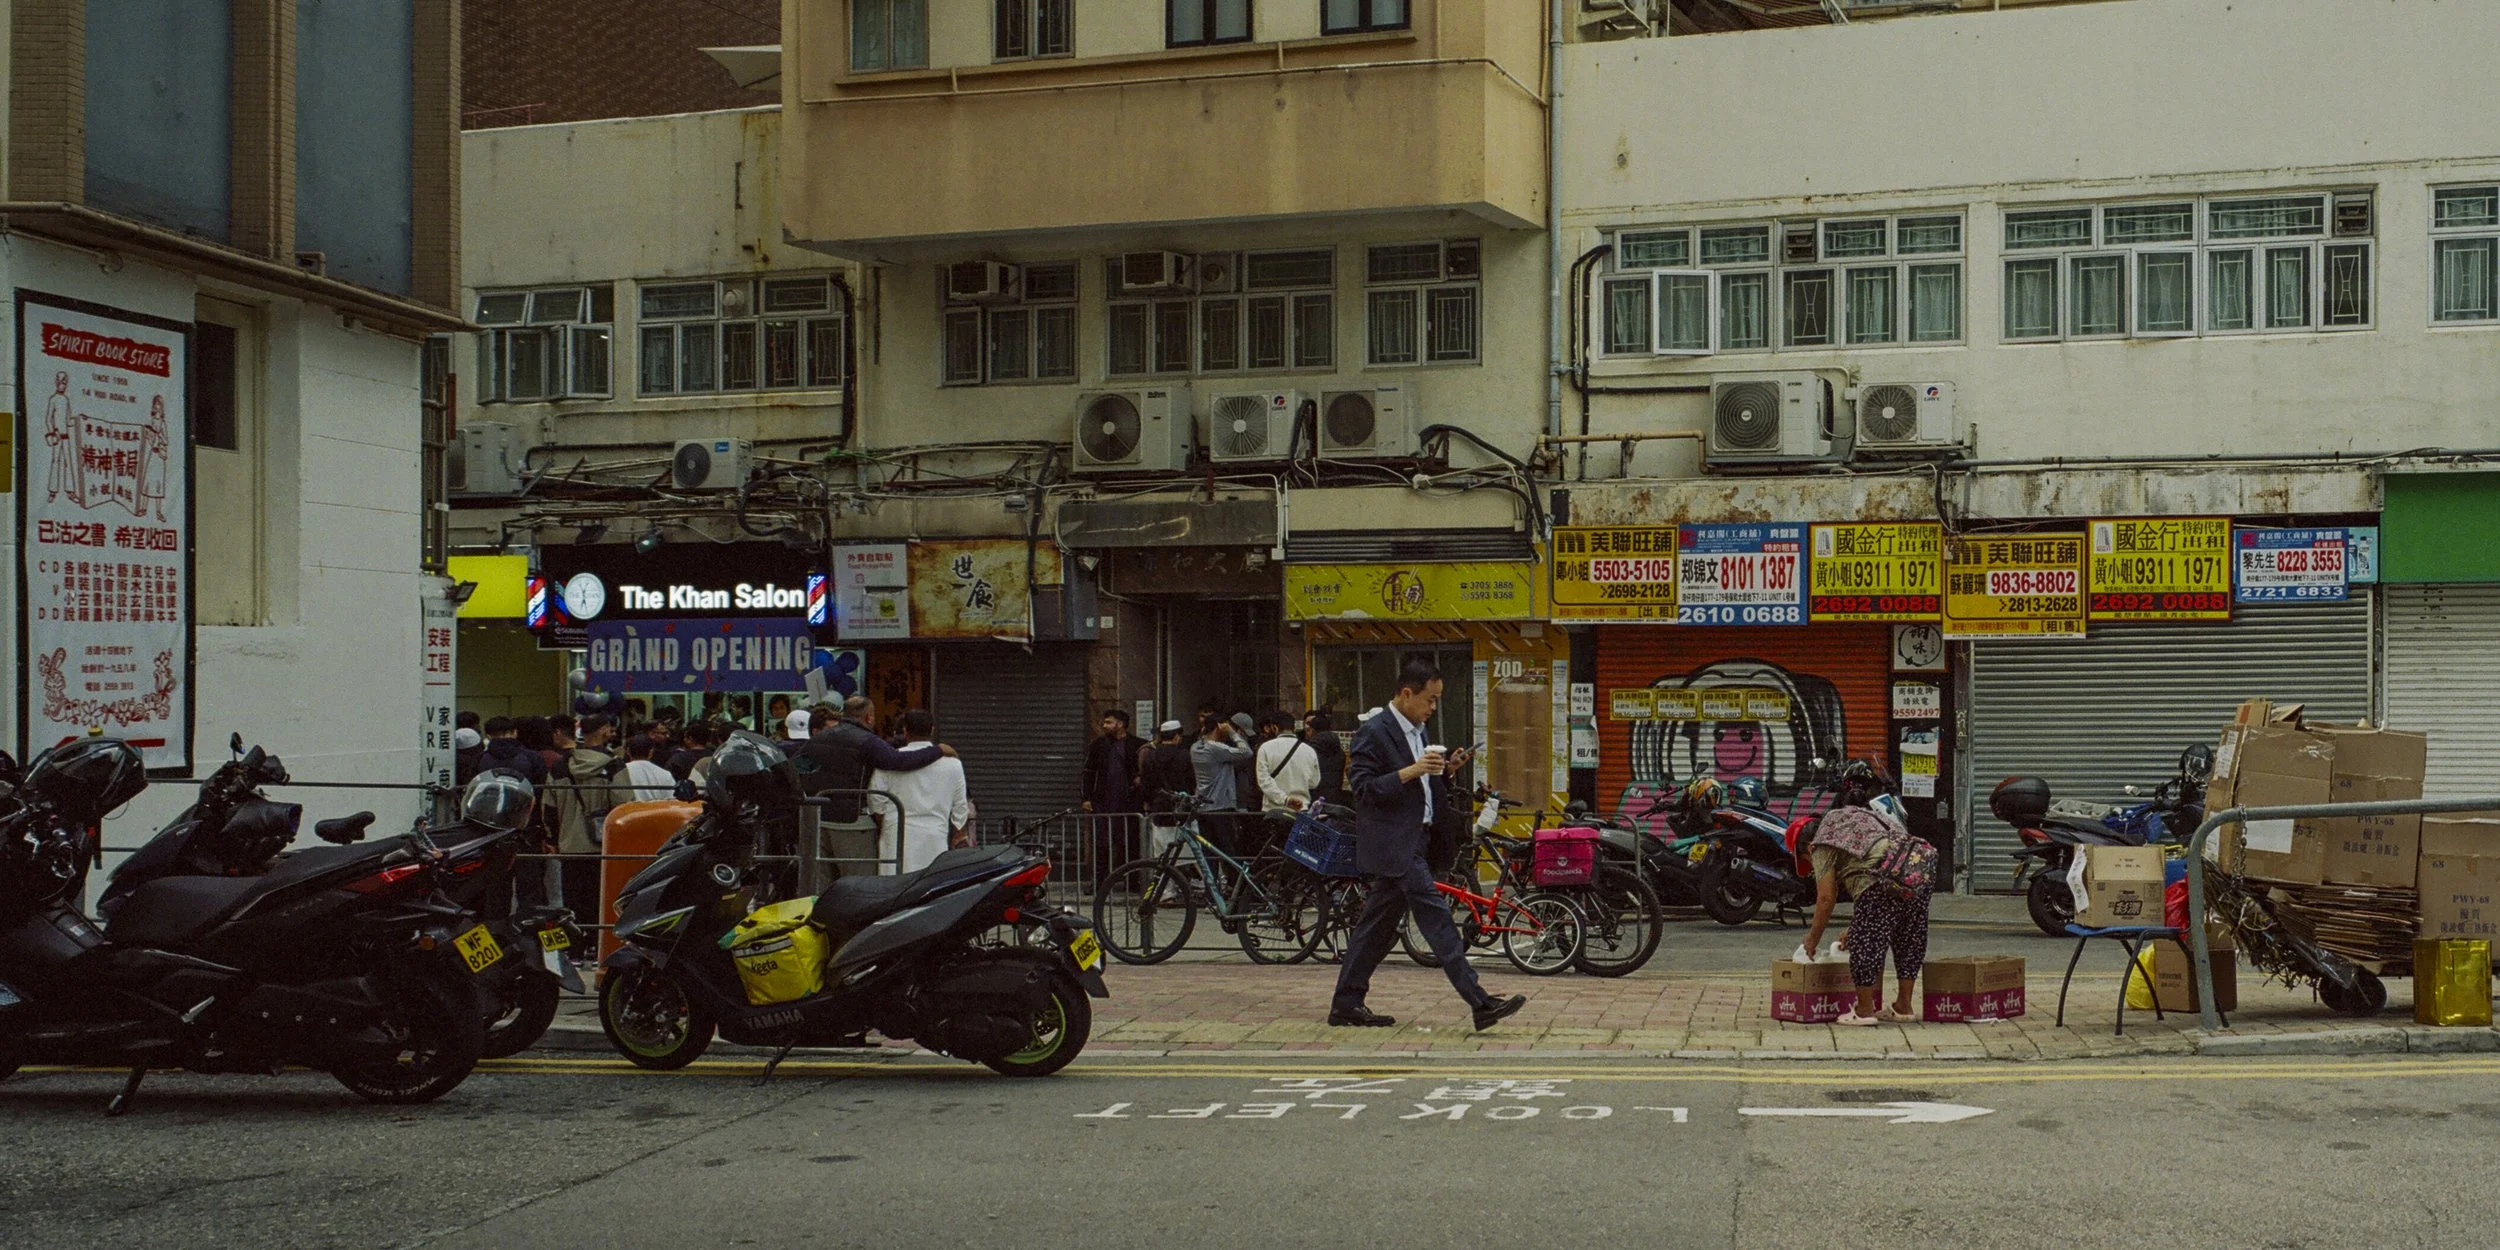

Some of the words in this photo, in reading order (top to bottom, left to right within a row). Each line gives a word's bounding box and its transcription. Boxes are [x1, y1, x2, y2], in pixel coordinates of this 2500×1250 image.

[49, 333, 94, 355] SPIRIT
[95, 342, 128, 361] BOOK
[129, 348, 165, 369] STORE
[82, 445, 138, 479] 精神書局
[115, 526, 177, 551] 希望收回
[1591, 532, 1672, 552] 美聯旺舖
[1836, 527, 1896, 555] 國金行
[1898, 526, 1938, 539] 特約代理
[2116, 522, 2179, 551] 國金行
[2182, 521, 2225, 535] 特約代理
[2182, 536, 2225, 548] 出租
[1899, 540, 1938, 552] 出租
[1988, 542, 2077, 564] 美聯旺舖
[1594, 560, 1670, 580] 5503-5105
[2243, 552, 2275, 569] 黎先生
[2277, 551, 2307, 572] 8228
[2312, 550, 2342, 571] 3553
[1681, 558, 1718, 584] 郑锦文
[1721, 556, 1753, 590] 8101
[1760, 556, 1795, 590] 1387
[1816, 561, 1852, 587] 黃小姐
[1854, 561, 1890, 587] 9311
[1900, 561, 1934, 587] 1971
[2094, 558, 2133, 585] 黃小姐
[2135, 557, 2174, 584] 9311
[2184, 557, 2222, 584] 1971
[1608, 584, 1670, 598] 2698-2128
[1991, 572, 2075, 594] 9836-8802
[2241, 587, 2287, 597] 2721
[2296, 587, 2343, 597] 6833
[620, 585, 664, 609] The
[669, 585, 730, 609] Khan
[735, 583, 805, 609] Salon
[1815, 596, 1871, 613] 2692
[1880, 596, 1937, 613] 0088
[2008, 597, 2077, 613] 2813-2628
[2093, 594, 2154, 610] 2692
[2162, 594, 2225, 610] 0088
[1678, 607, 1735, 623] 2610
[1743, 607, 1800, 623] 0688
[428, 653, 450, 672] 工程
[591, 637, 678, 671] GRAND
[692, 636, 810, 671] OPENING
[2433, 861, 2444, 869] 68
[2452, 895, 2490, 904] PWY-68
[465, 932, 482, 951] WF
[469, 944, 499, 969] 8201
[1779, 996, 1797, 1012] vita
[1811, 995, 1840, 1013] vita
[1935, 996, 1962, 1012] vita
[1979, 994, 1998, 1013] vita
[2002, 991, 2021, 1009] vita
[744, 1008, 805, 1029] YAMAHA
[1073, 1102, 1367, 1121] LEFT
[1399, 1102, 1689, 1123] LOOK
